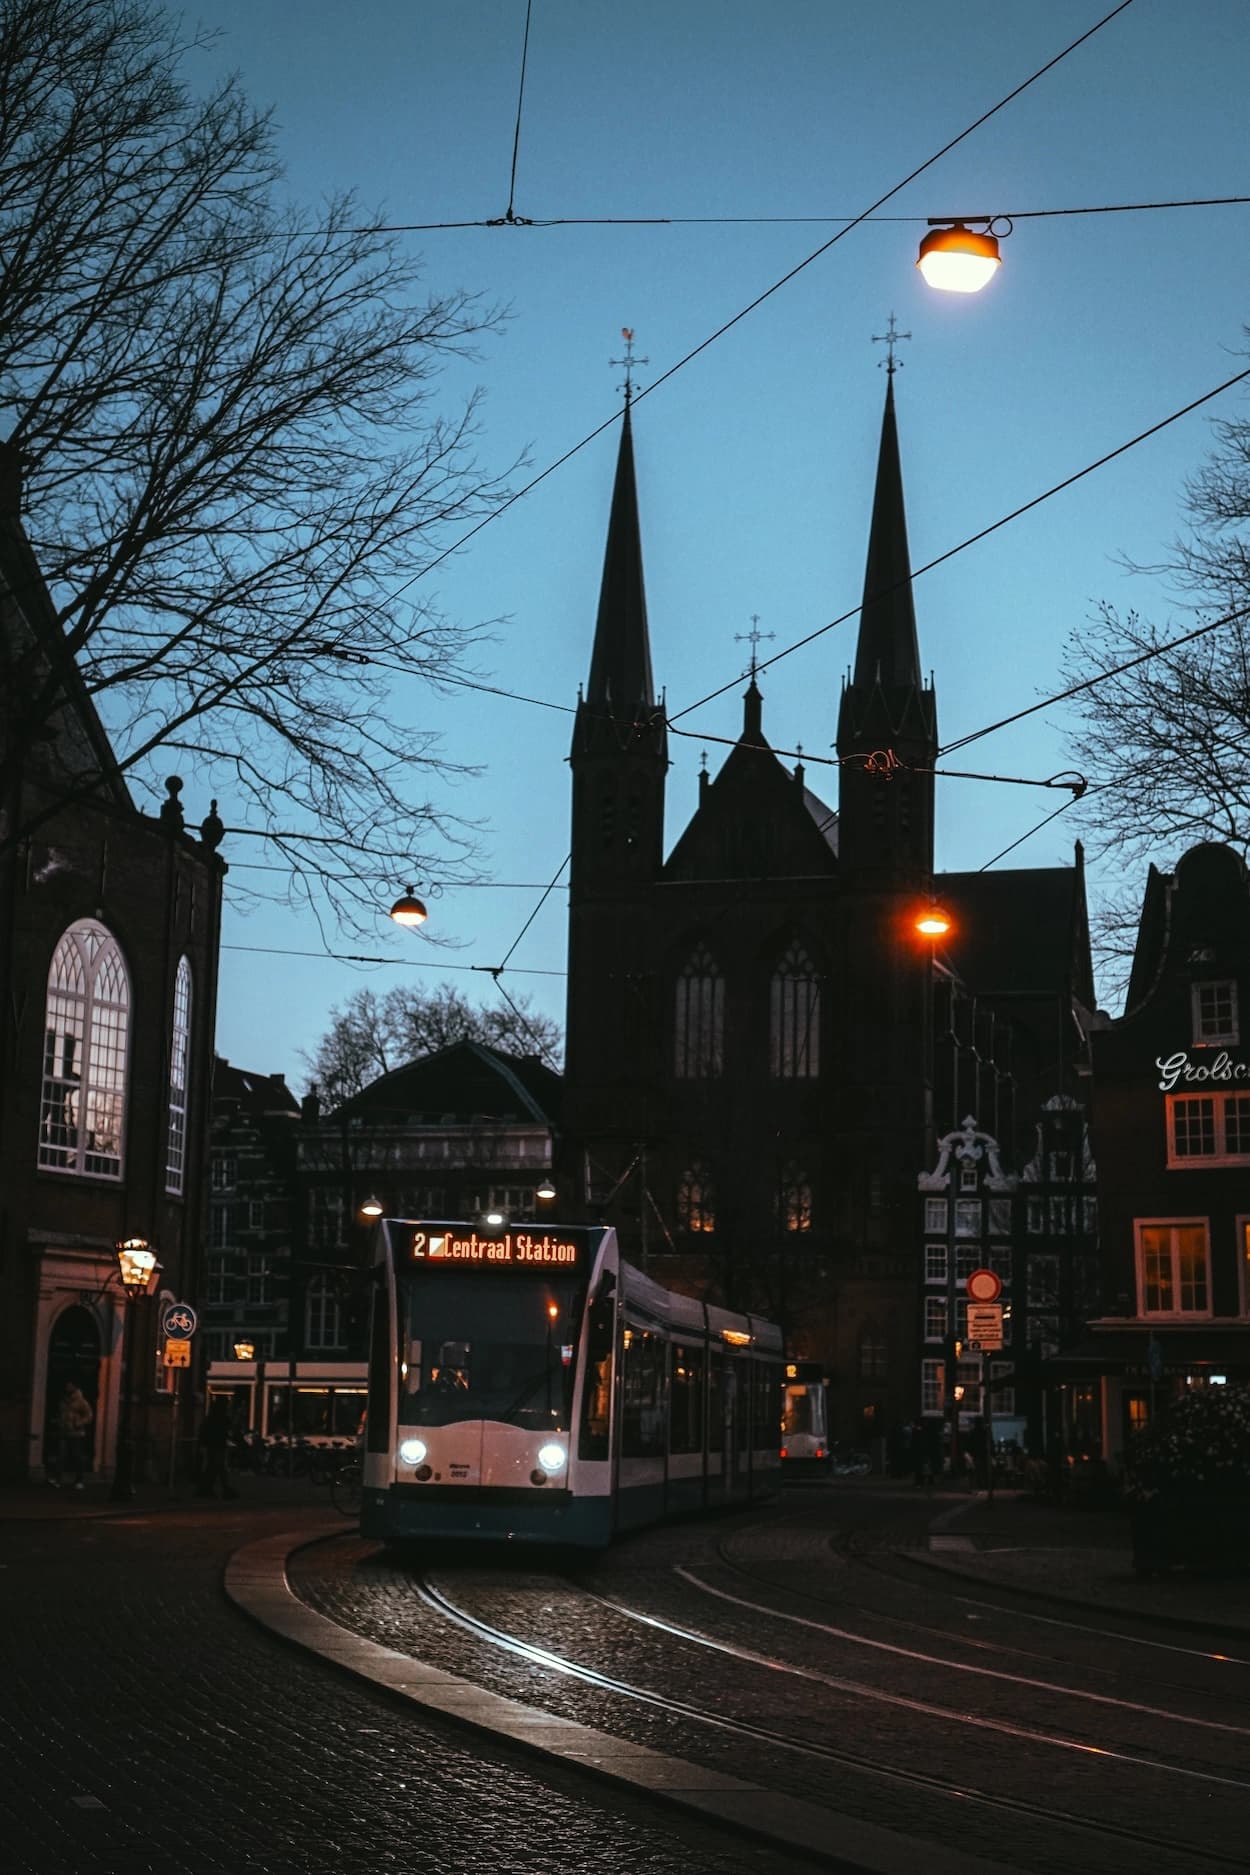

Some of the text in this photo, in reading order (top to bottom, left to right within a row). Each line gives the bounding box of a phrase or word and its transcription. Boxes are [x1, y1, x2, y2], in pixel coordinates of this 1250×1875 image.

[1155, 1051, 1250, 1091] Grolsc
[414, 1232, 576, 1262] 2 Centraal Station
